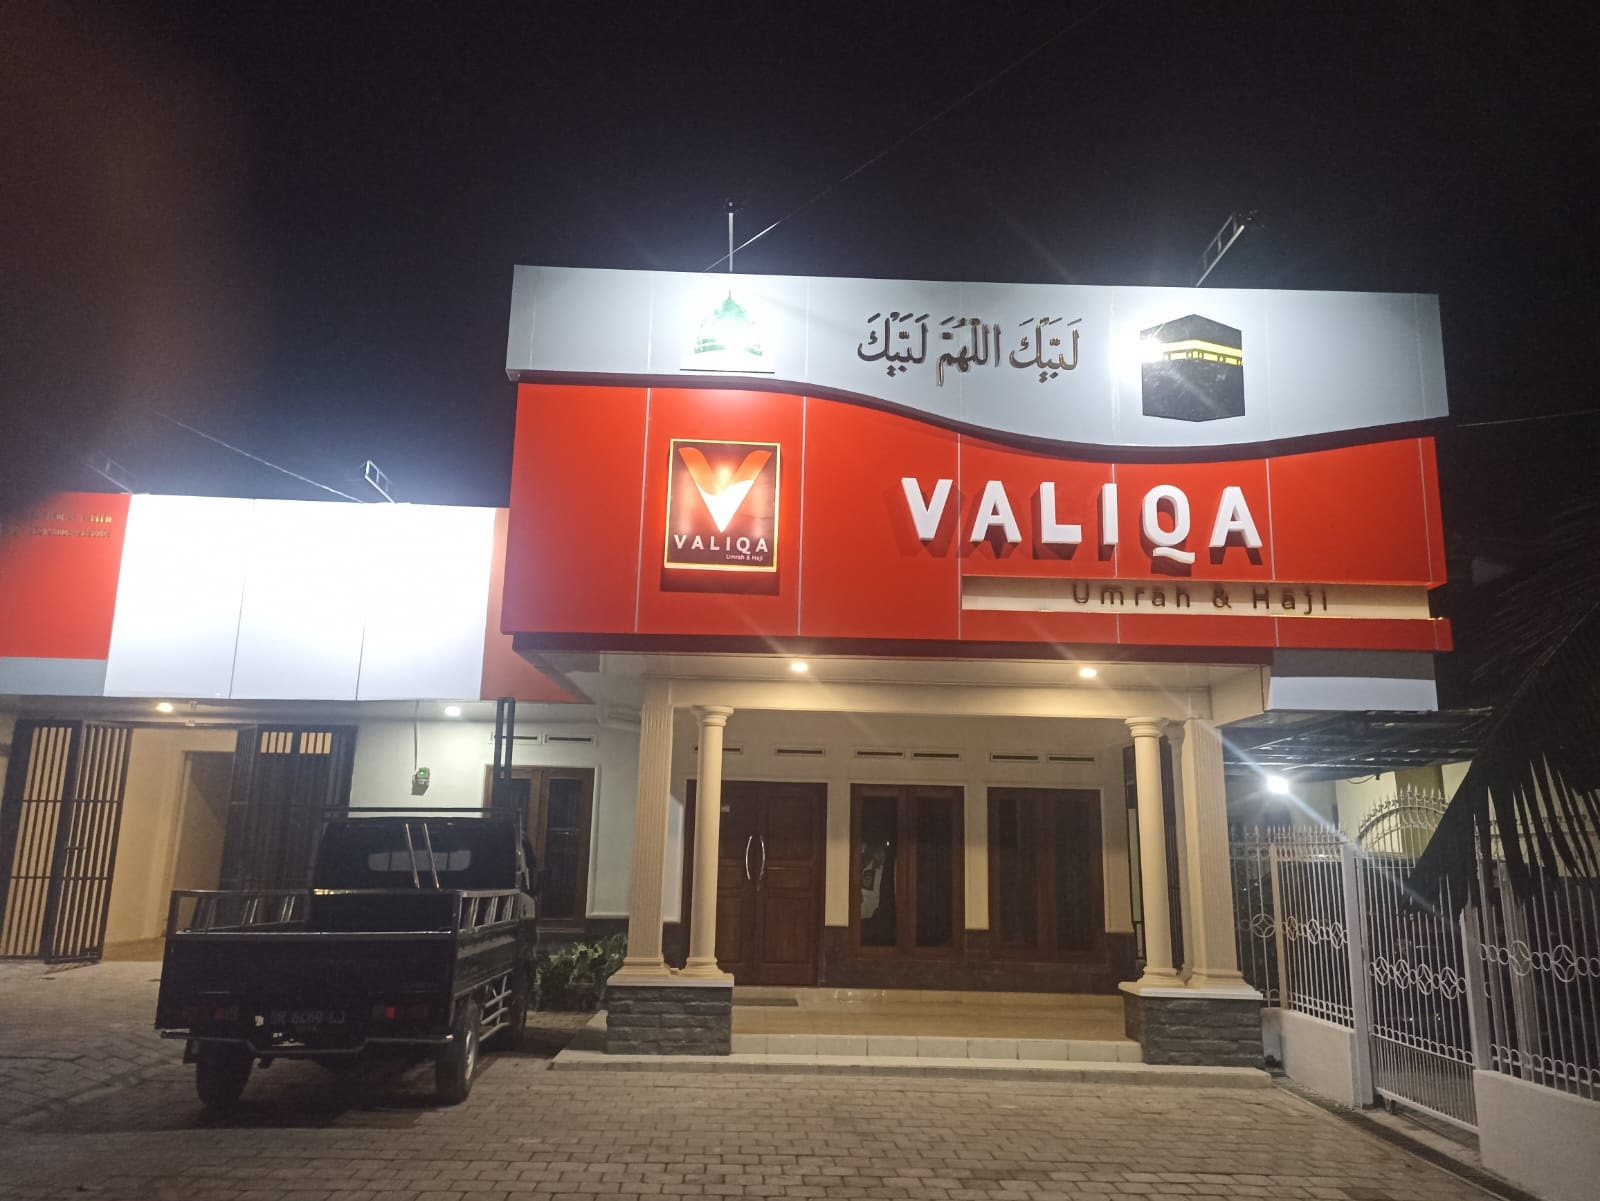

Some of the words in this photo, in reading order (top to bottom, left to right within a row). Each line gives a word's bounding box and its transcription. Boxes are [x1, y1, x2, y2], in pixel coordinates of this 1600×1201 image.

[901, 477, 1264, 565] VALIQA
[674, 534, 769, 554] VALIQA
[1072, 583, 1191, 608] Umrah
[1212, 584, 1233, 609] &
[1252, 586, 1328, 616] Haji
